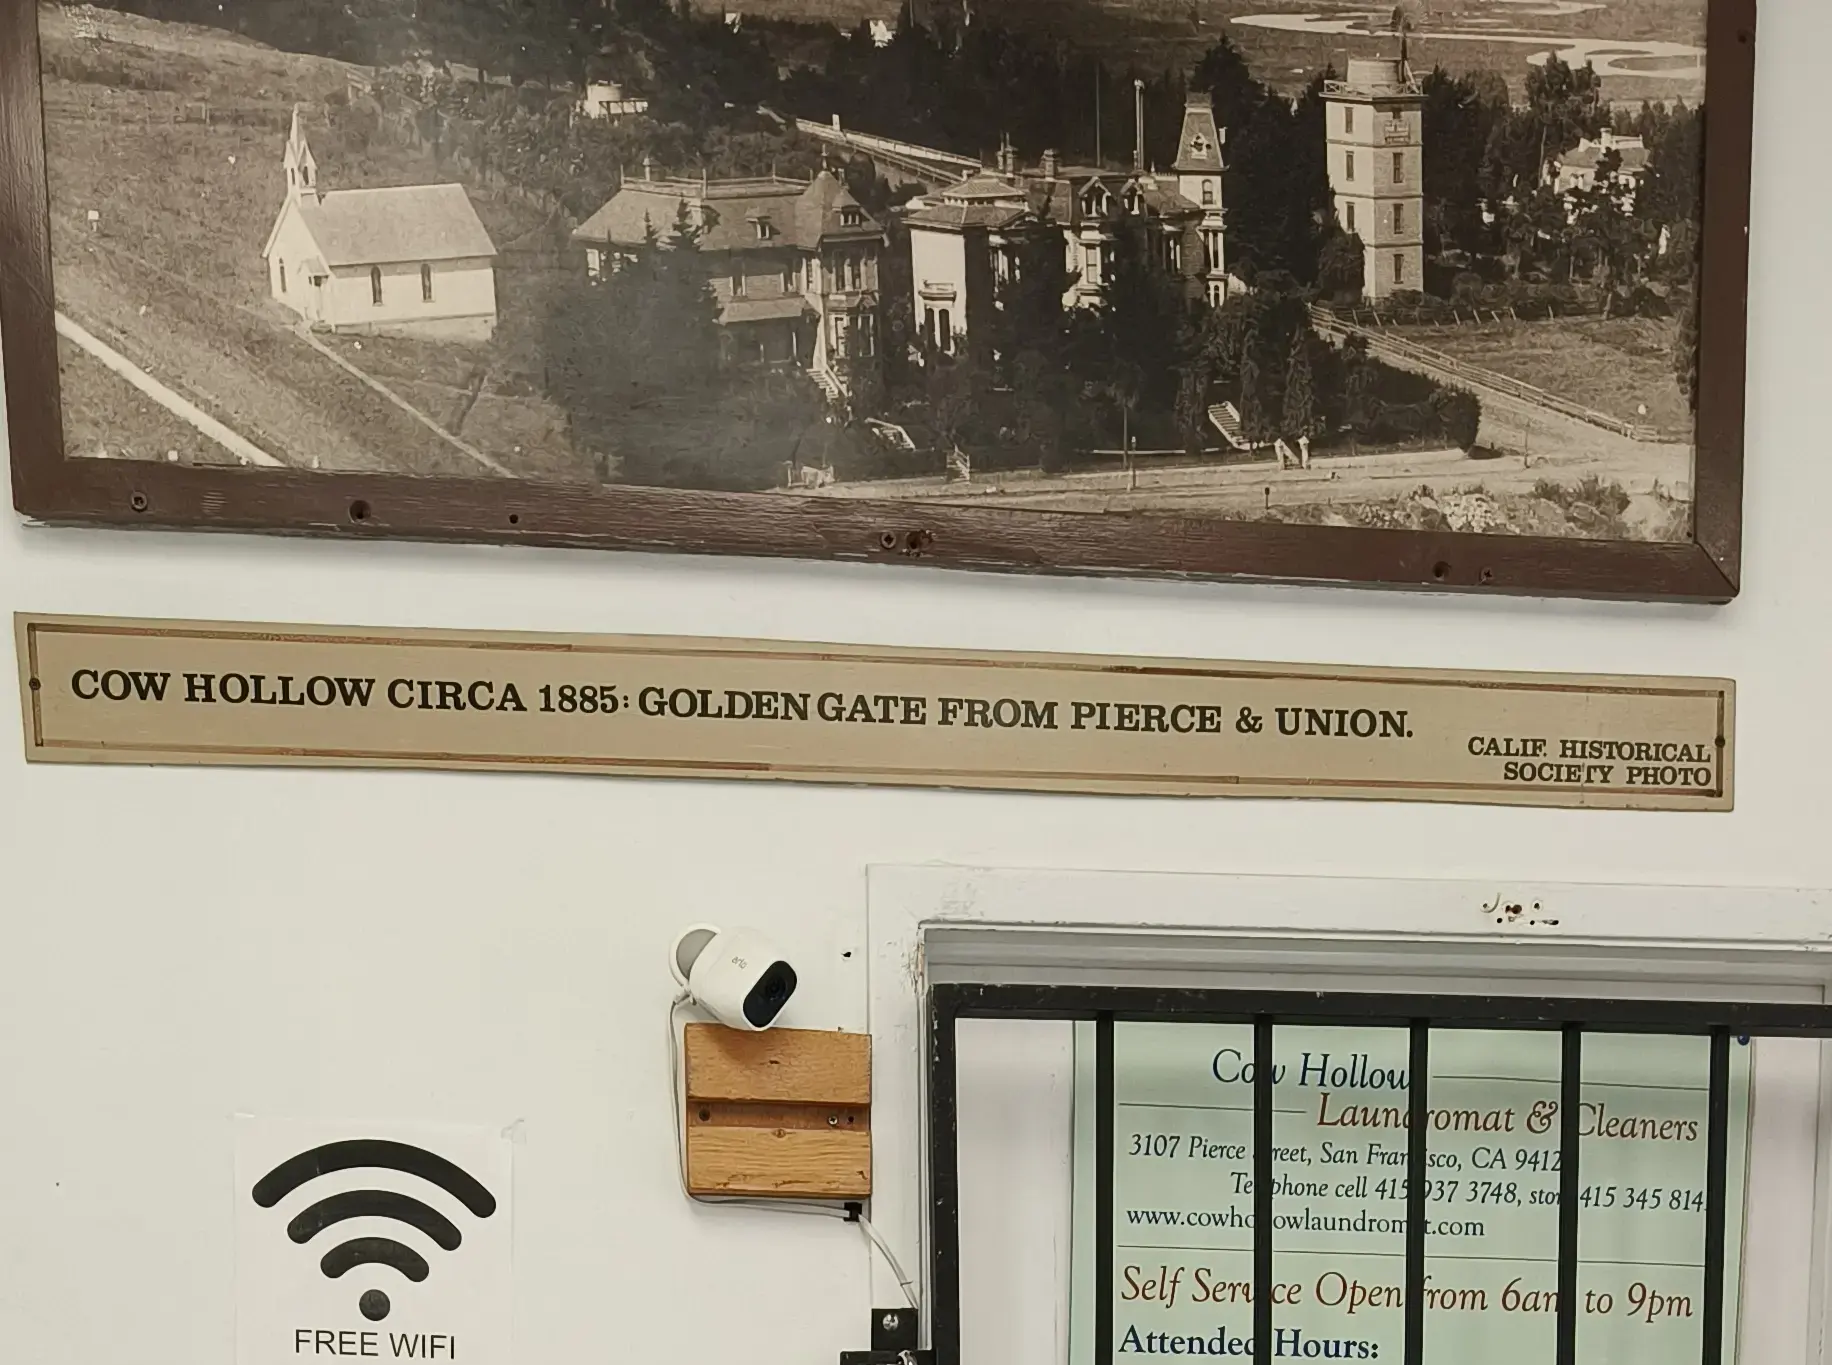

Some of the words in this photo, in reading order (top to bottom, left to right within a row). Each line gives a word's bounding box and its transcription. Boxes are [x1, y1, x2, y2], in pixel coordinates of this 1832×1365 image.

[71, 668, 172, 703] COW
[183, 672, 375, 708] HOLLOW
[387, 677, 527, 713] CIRCA
[538, 683, 631, 715] 1885:
[639, 686, 811, 722] GOLDEN
[817, 693, 927, 727] GATE
[936, 698, 1058, 730] FROM
[1071, 702, 1223, 735] PIERCE
[1235, 706, 1263, 734] &
[1276, 707, 1415, 739] UNION.
[1467, 736, 1548, 759] CALIF.
[1559, 739, 1712, 764] HISTORICAL
[1503, 762, 1614, 784] SOCIETY
[1626, 765, 1713, 787] PHOTO
[1298, 1052, 1411, 1090] Hollow
[1526, 1100, 1559, 1135] &
[1128, 1133, 1181, 1158] 3107
[1188, 1136, 1246, 1161] Pierce
[1320, 1141, 1359, 1166] San
[1471, 1146, 1507, 1171] CA
[1515, 1149, 1561, 1173] 9412
[1230, 1171, 1329, 1200] Tephone
[1334, 1175, 1368, 1199] cell
[1466, 1181, 1522, 1208] 3748,
[1580, 1185, 1617, 1209] 415
[1623, 1187, 1663, 1211] 345
[1668, 1189, 1707, 1214] 814
[1121, 1264, 1185, 1308] Self
[1315, 1271, 1404, 1315] Open
[1585, 1288, 1614, 1315] to
[1627, 1282, 1694, 1324] 9pm
[294, 1329, 379, 1357] FREE
[389, 1333, 456, 1360] WIFI
[1273, 1328, 1379, 1360] Hours:
